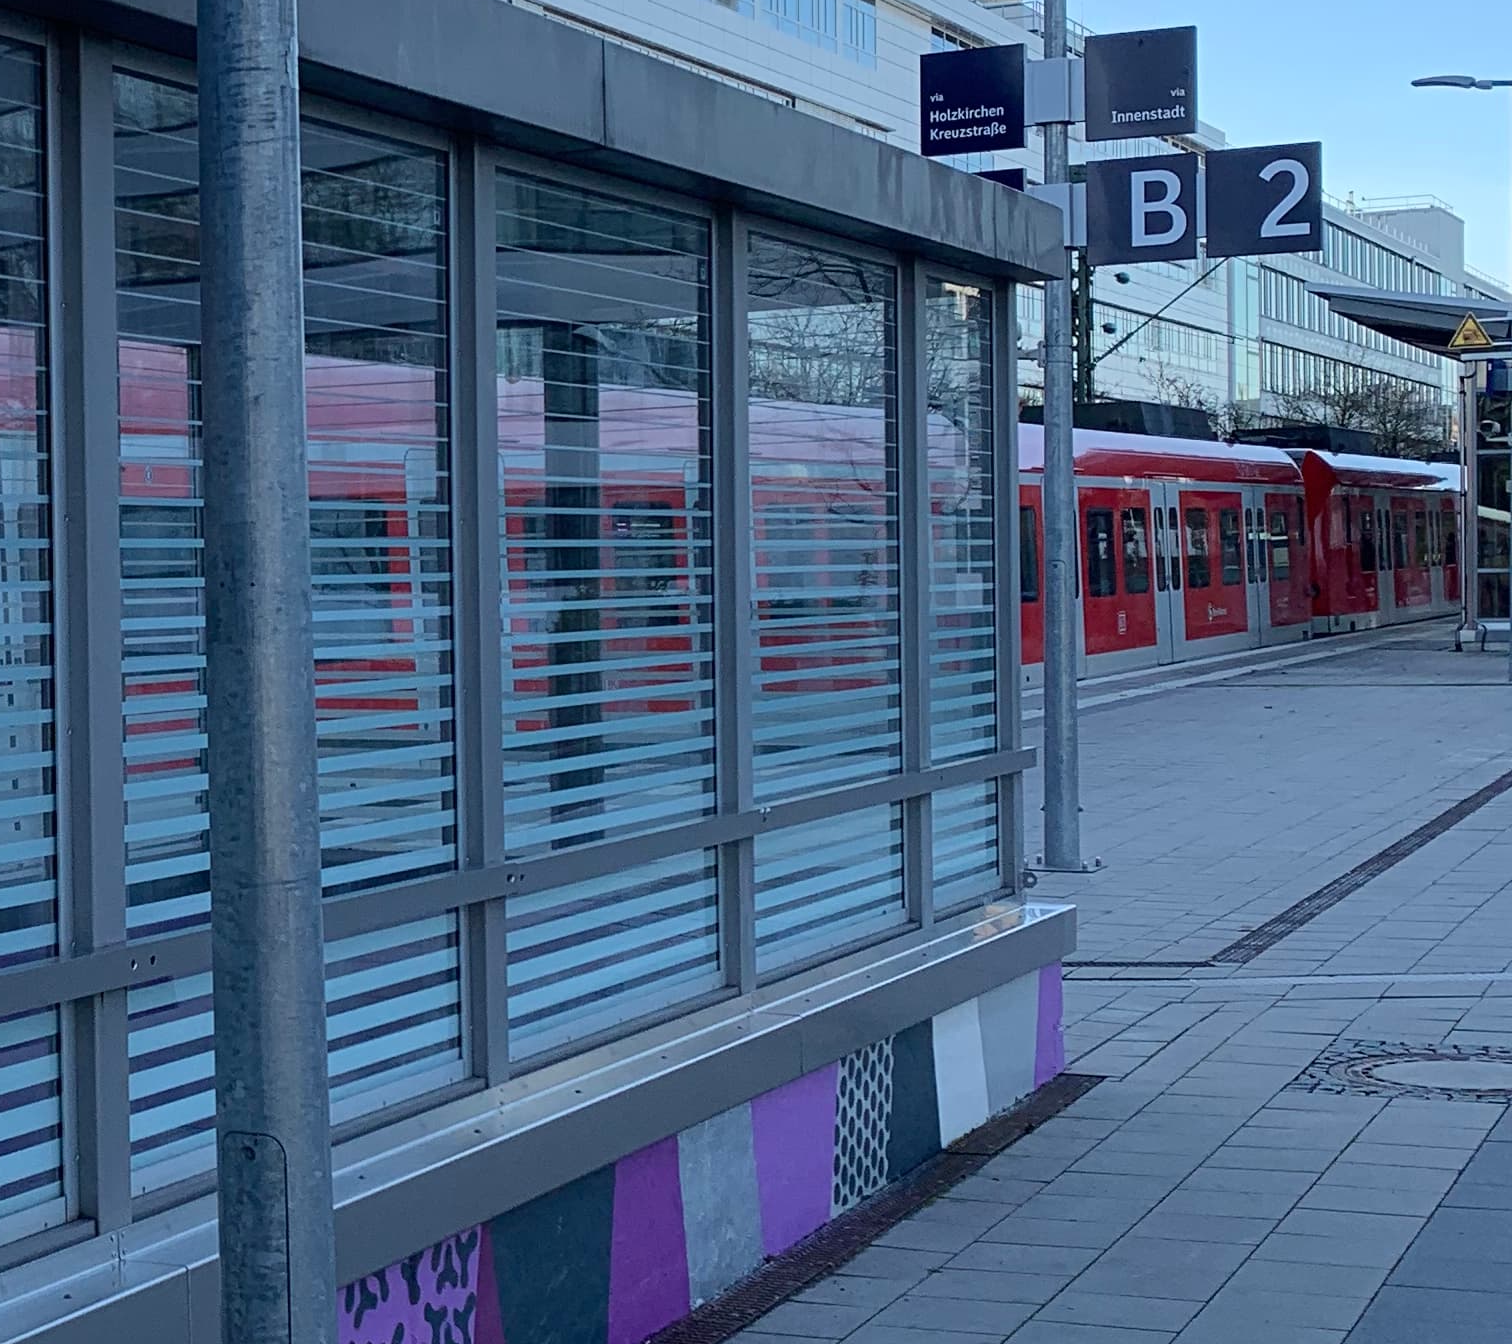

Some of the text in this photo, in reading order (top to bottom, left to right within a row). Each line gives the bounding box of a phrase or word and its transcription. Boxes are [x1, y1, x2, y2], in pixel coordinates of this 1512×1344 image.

[929, 92, 944, 102] via
[1170, 87, 1186, 97] via
[930, 104, 1004, 123] Holzkirchen
[1111, 104, 1185, 123] Innenstadt
[930, 122, 1007, 141] Kreuzstraße
[1258, 158, 1311, 239] 2
[1130, 169, 1188, 248] B
